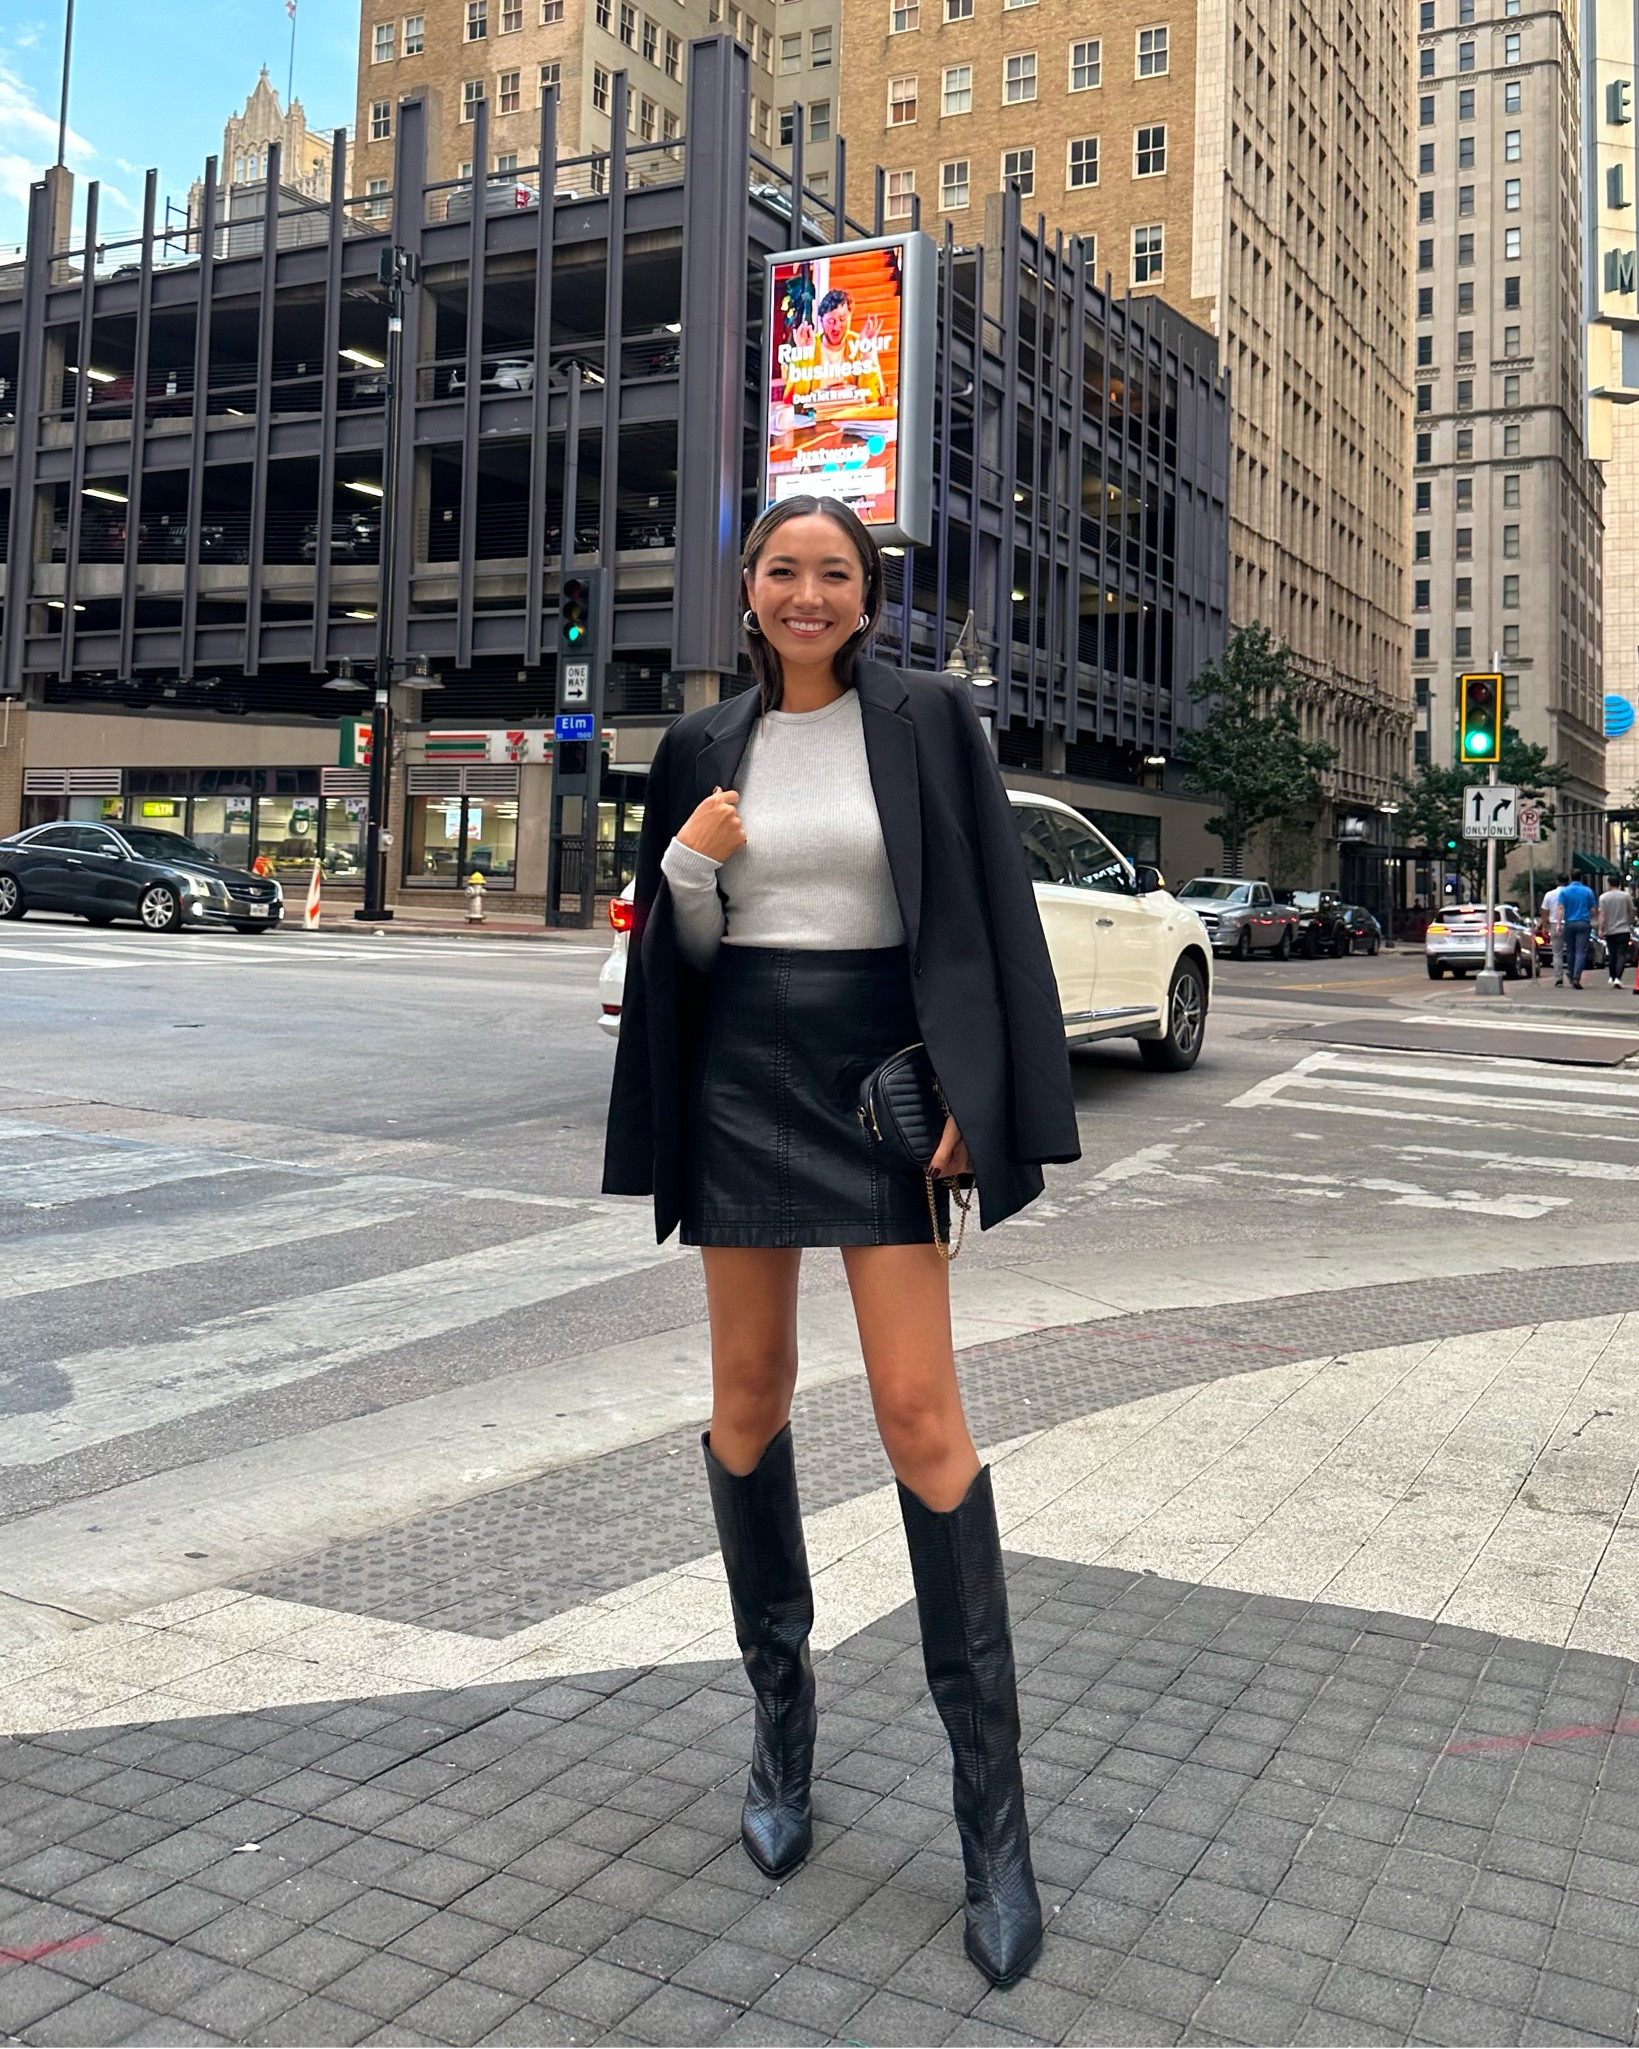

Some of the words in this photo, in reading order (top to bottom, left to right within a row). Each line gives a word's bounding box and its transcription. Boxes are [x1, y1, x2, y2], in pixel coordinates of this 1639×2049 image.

[1608, 79, 1637, 295] ELM
[778, 344, 814, 364] Run
[848, 336, 892, 359] your
[789, 360, 877, 382] business.
[568, 667, 585, 677] ONE
[568, 677, 586, 687] WAY
[562, 717, 586, 729] Elm
[1465, 826, 1488, 835] ONLY
[1490, 826, 1513, 835] ONLY
